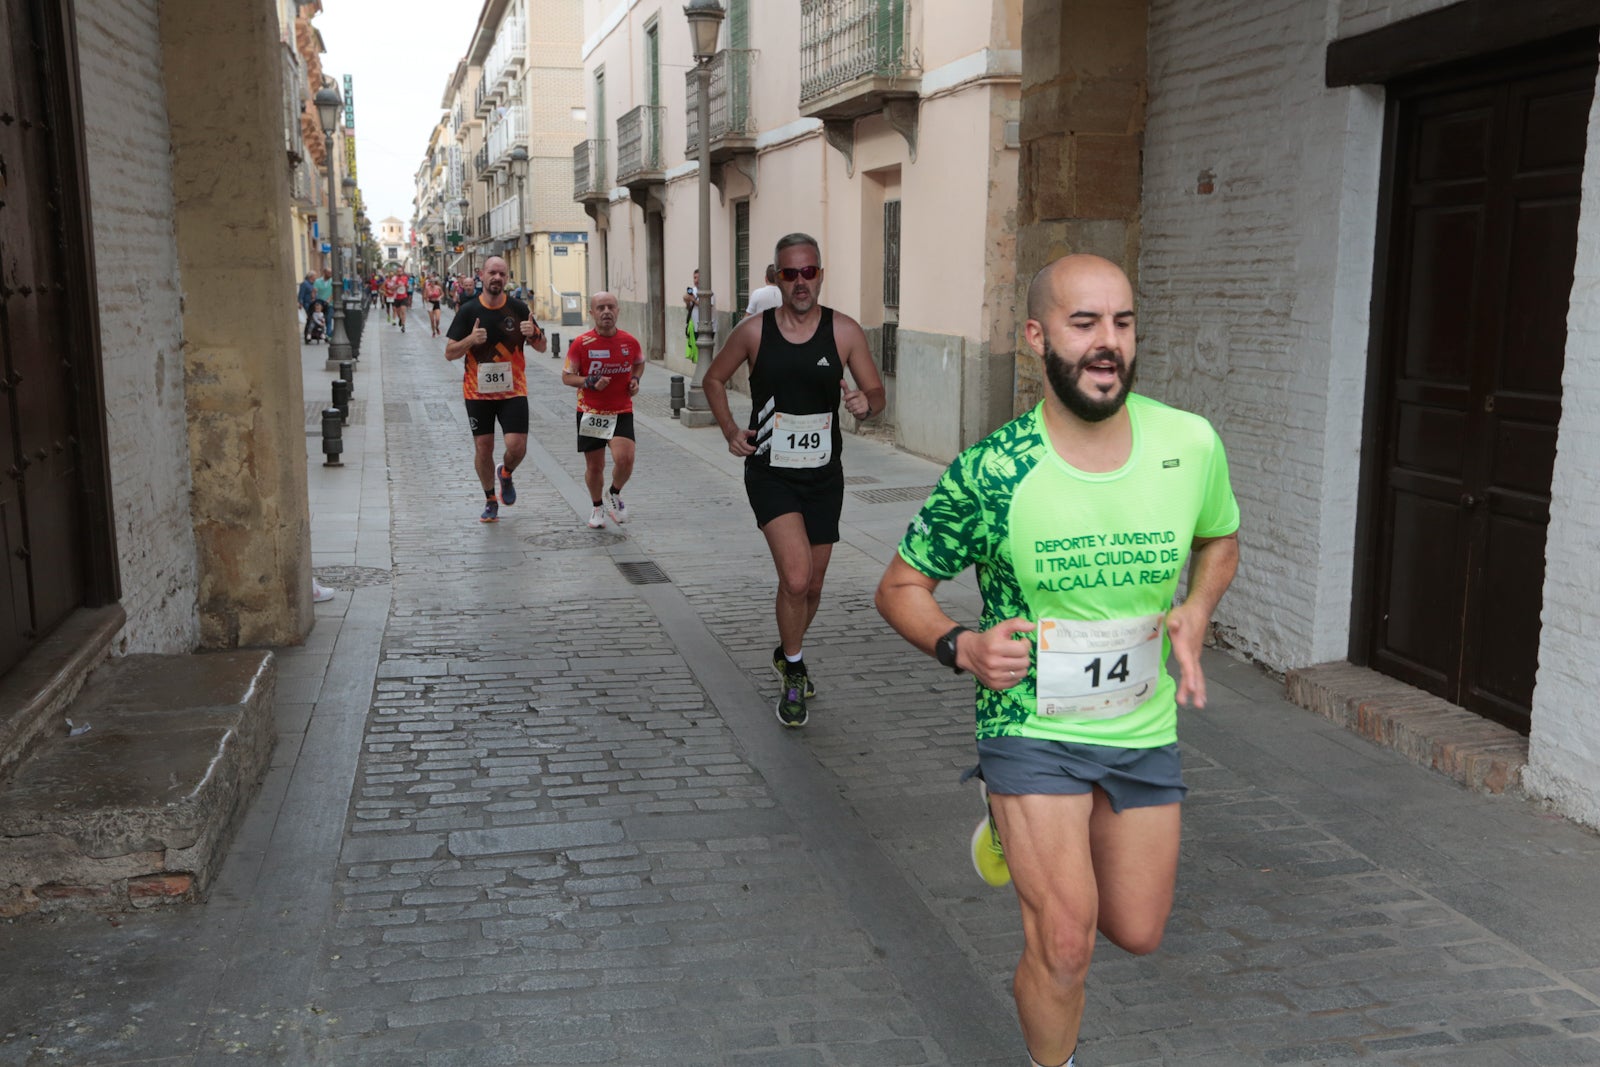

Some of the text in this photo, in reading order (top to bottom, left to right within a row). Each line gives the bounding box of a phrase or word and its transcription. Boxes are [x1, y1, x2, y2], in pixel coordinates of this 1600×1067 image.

[343, 75, 354, 128] TEJIDOS
[485, 373, 505, 383] 381
[589, 417, 610, 429] 382
[787, 432, 820, 449] 149
[1035, 531, 1175, 553] DEPORTE Y JUVENTUD
[1036, 548, 1179, 573] II TRAIL CIUDAD DE
[1036, 569, 1107, 592] ALCALÁ
[1112, 571, 1134, 586] LA
[1084, 653, 1130, 688] 14
